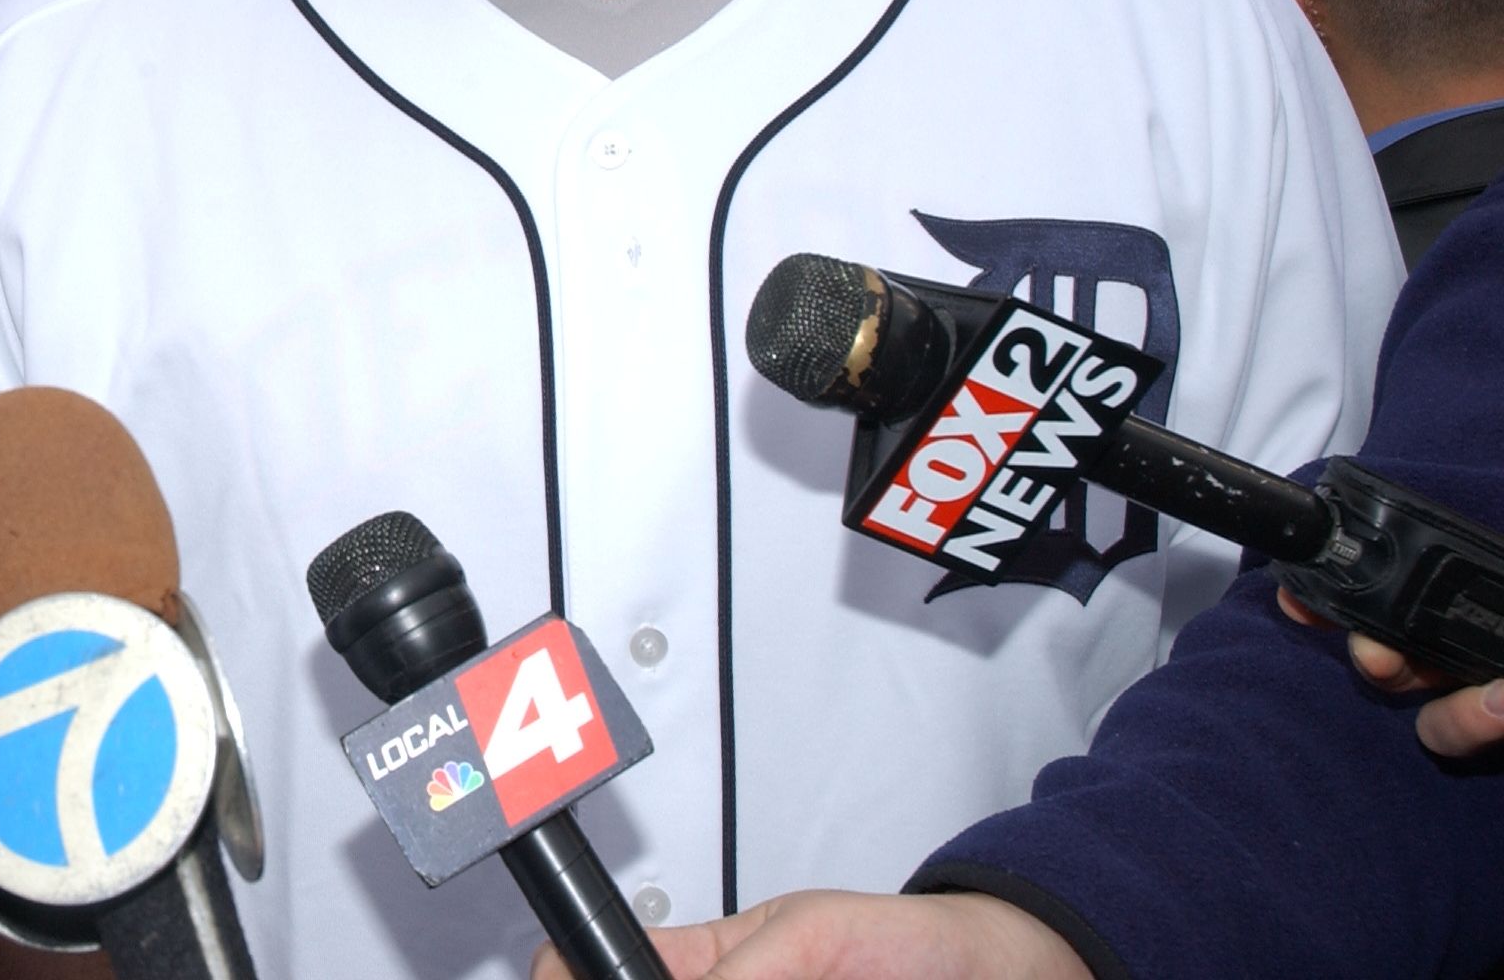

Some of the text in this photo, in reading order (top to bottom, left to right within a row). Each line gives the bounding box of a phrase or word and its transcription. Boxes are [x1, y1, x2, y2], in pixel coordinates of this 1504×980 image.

[868, 326, 1077, 547] FOX 2
[942, 355, 1138, 572] NEWS
[366, 647, 594, 781] LOCAL 4
